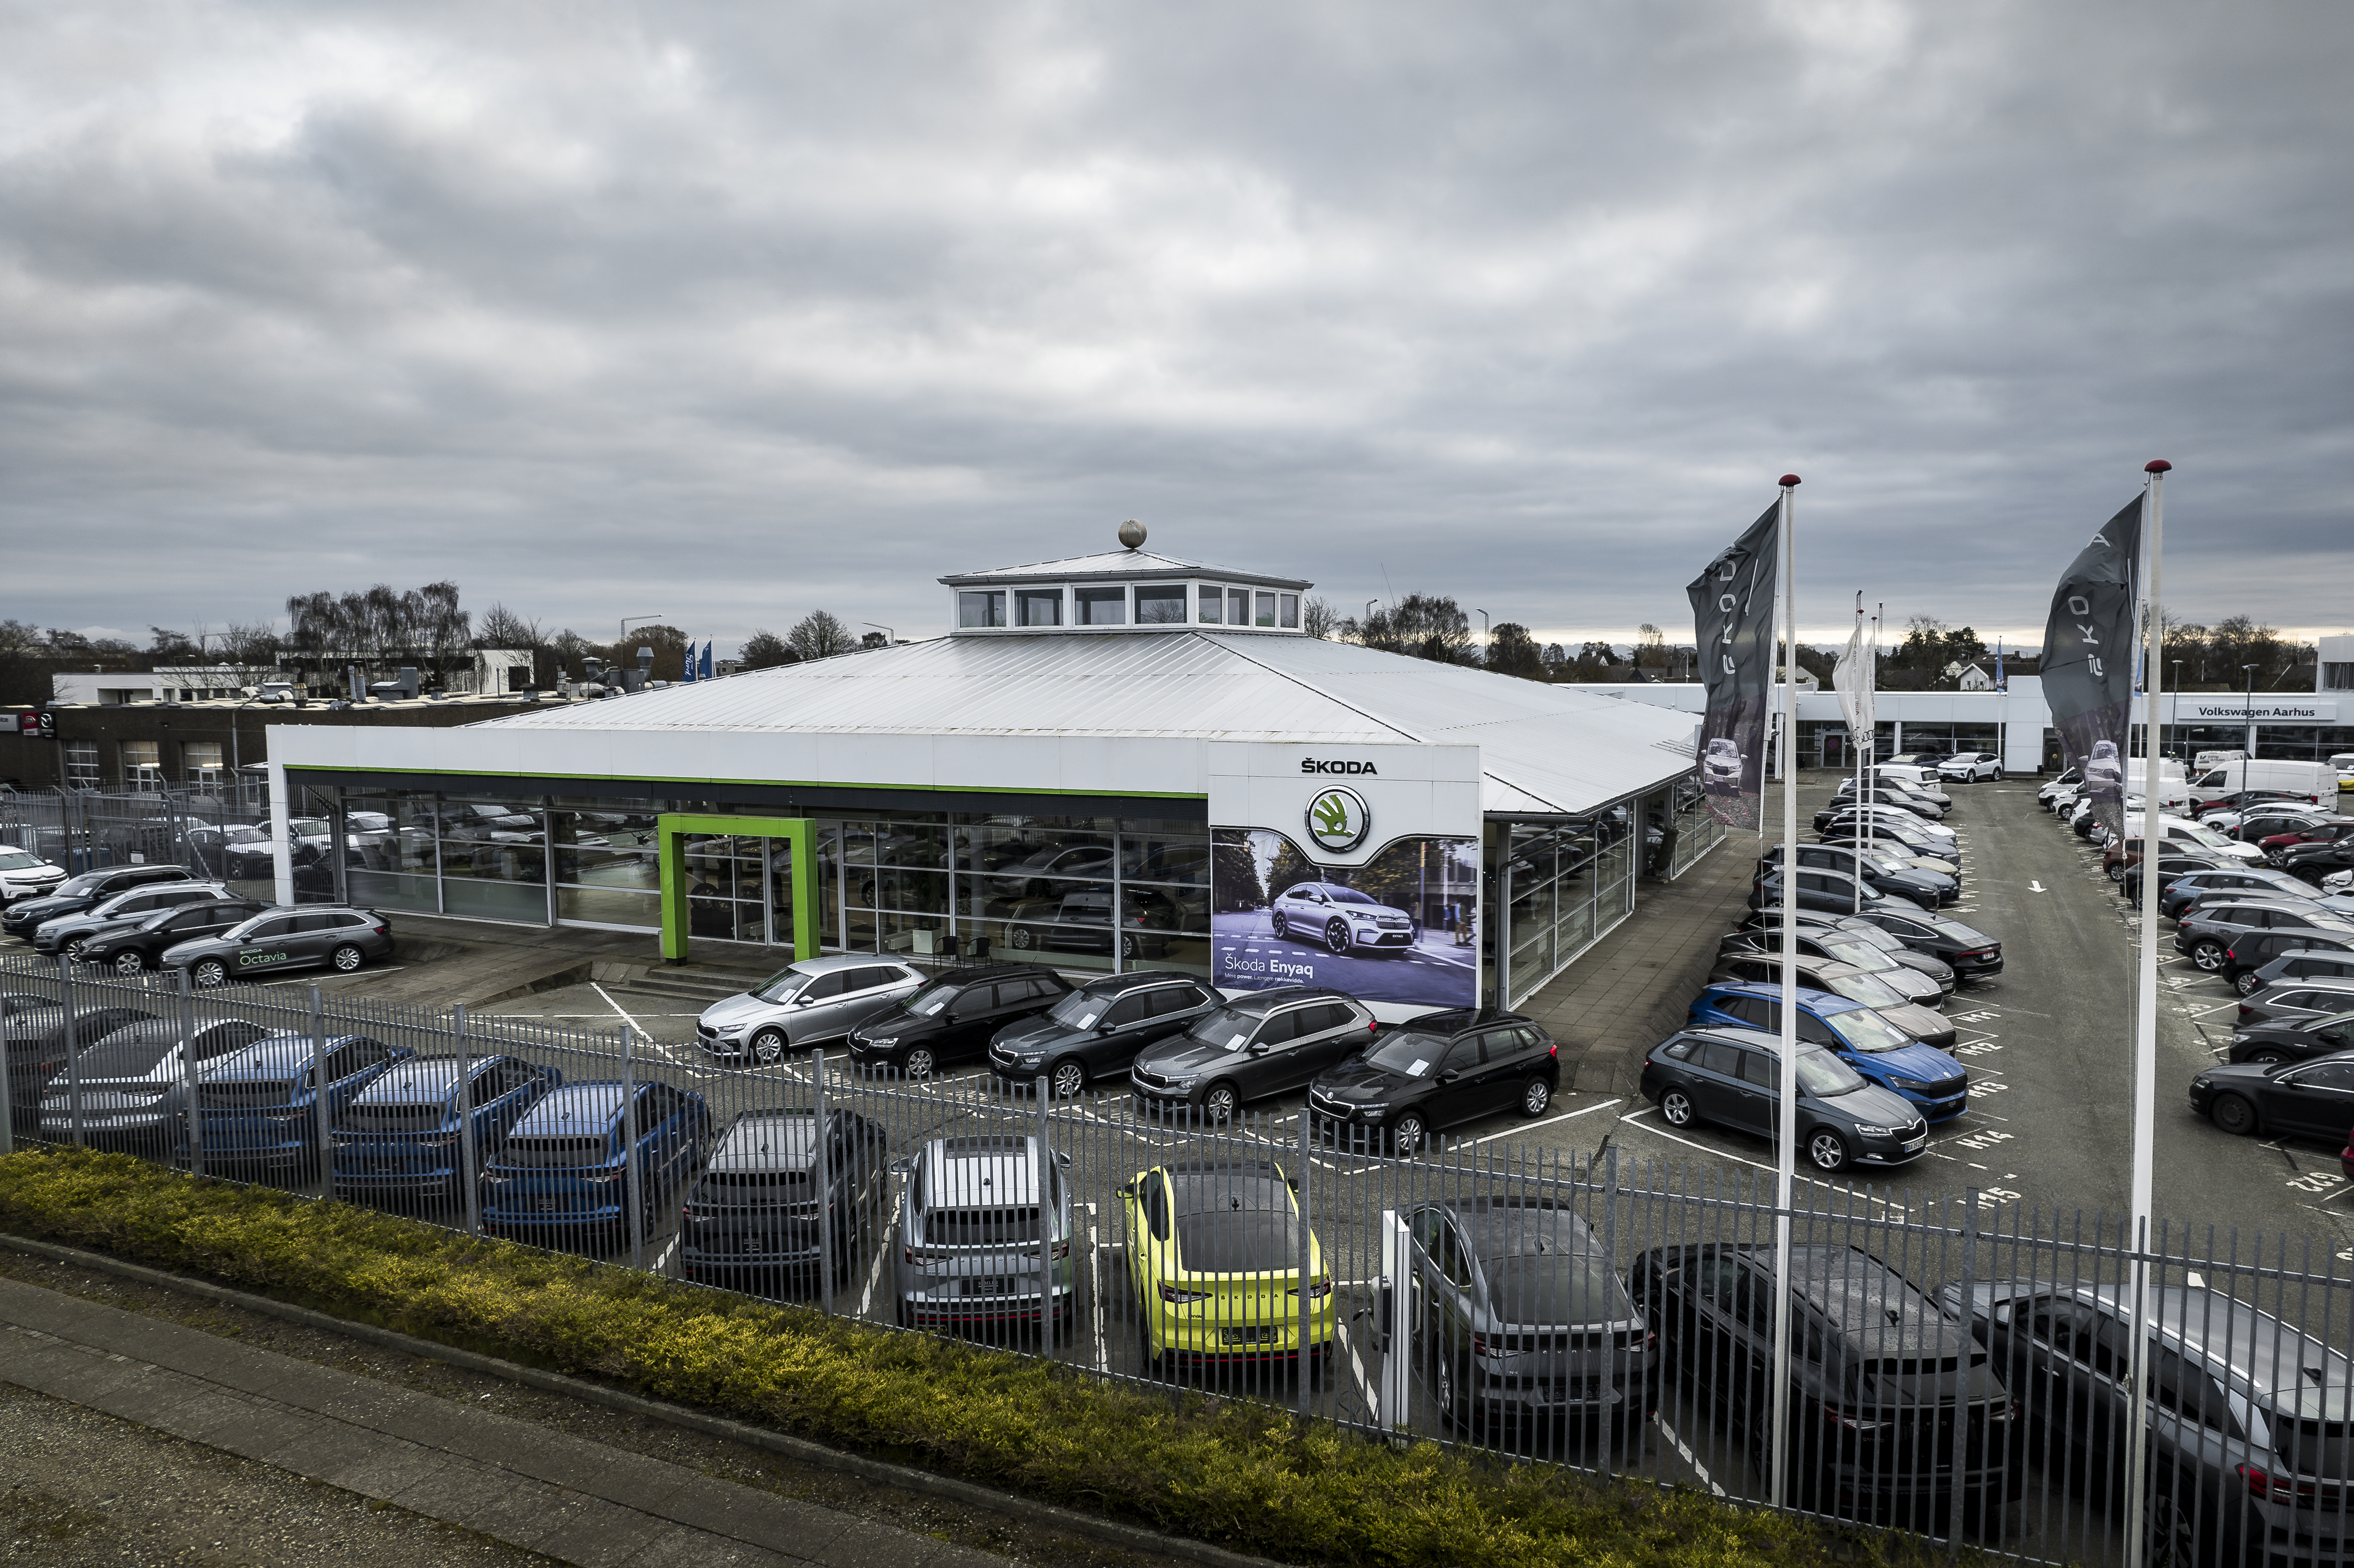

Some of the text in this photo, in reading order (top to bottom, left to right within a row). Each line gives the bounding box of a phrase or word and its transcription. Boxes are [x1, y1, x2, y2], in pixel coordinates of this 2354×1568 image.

[2199, 707, 2315, 718] Volkswagen Aarhus
[1301, 757, 1378, 775] ŠKODA
[240, 952, 286, 965] Octavia
[1225, 952, 1313, 979] Škoda Enyaq
[1956, 1011, 2001, 1023] H11
[1955, 1042, 2004, 1056] H12
[1968, 1082, 2009, 1098] H13
[1955, 1130, 2014, 1149] H14
